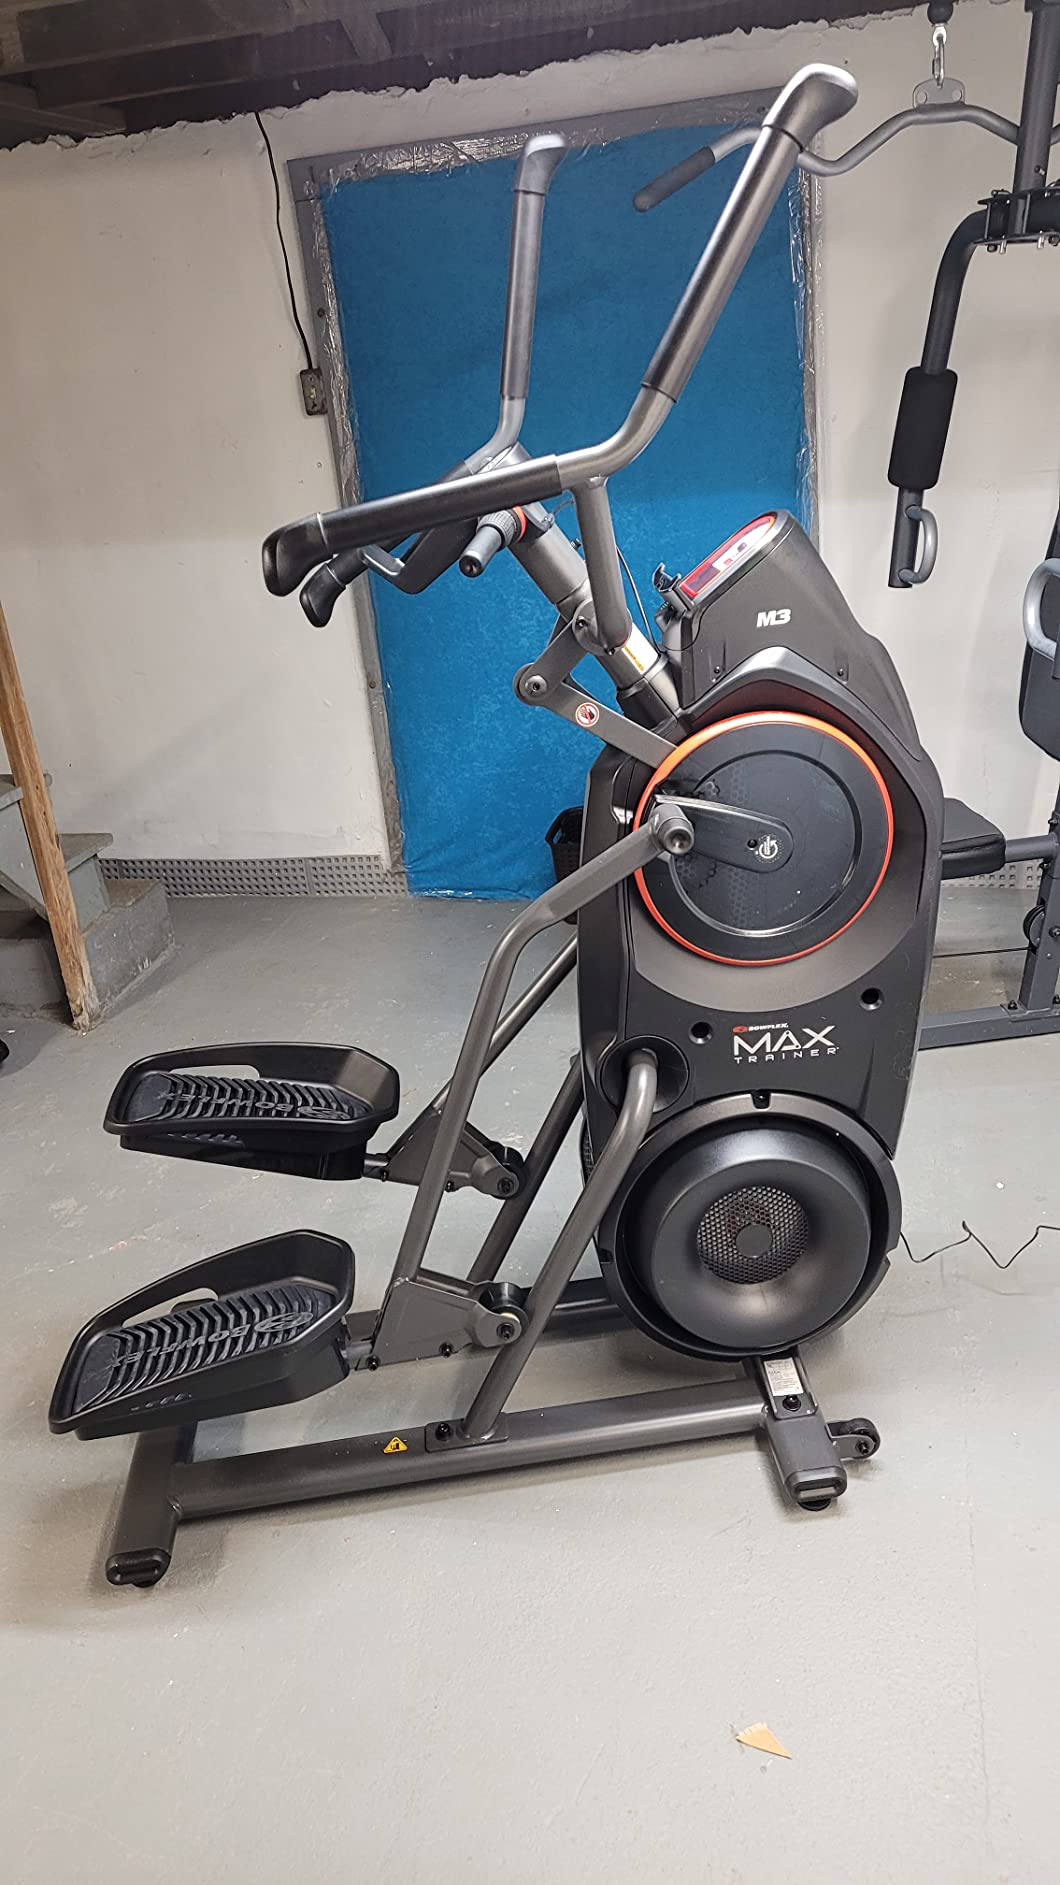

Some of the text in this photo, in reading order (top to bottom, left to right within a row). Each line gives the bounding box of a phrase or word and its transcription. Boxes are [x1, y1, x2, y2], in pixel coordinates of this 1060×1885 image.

[756, 608, 792, 628] M3
[748, 1022, 788, 1032] BOWFLEX
[733, 1025, 836, 1056] MAX
[734, 1046, 839, 1065] TRAINER
[105, 1324, 251, 1369] BOWFLEX
